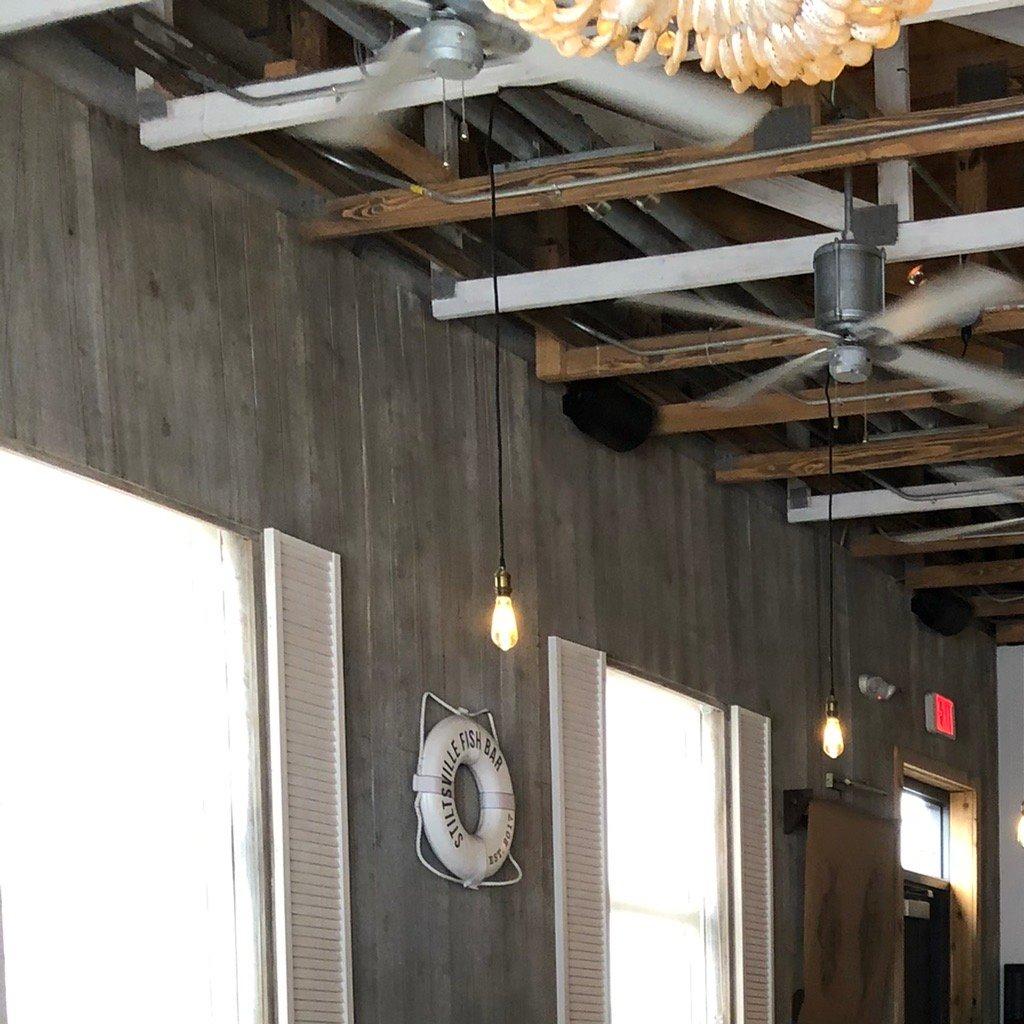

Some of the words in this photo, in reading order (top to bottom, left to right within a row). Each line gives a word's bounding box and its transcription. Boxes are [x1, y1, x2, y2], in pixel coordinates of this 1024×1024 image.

[441, 740, 463, 848] STILTSVILLE
[459, 730, 481, 751] FISH
[484, 738, 502, 772] BAR
[489, 848, 505, 865] EST.
